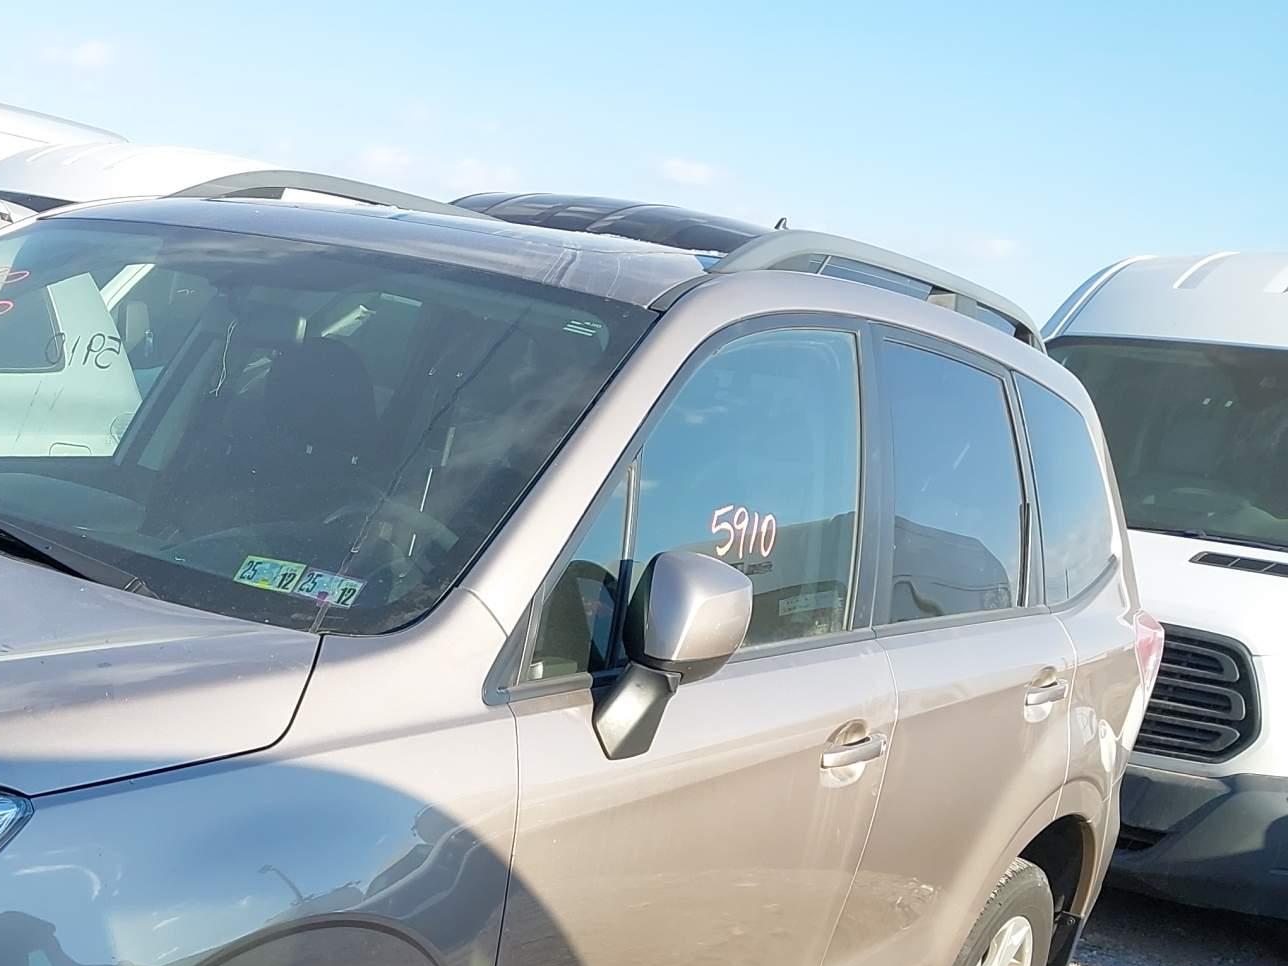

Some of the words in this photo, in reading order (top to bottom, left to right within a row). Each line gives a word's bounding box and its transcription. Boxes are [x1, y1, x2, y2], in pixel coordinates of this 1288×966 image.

[711, 504, 777, 560] 5910
[239, 560, 263, 580] 25
[276, 572, 297, 590] 12
[298, 572, 323, 593] 25
[336, 587, 357, 606] 12
